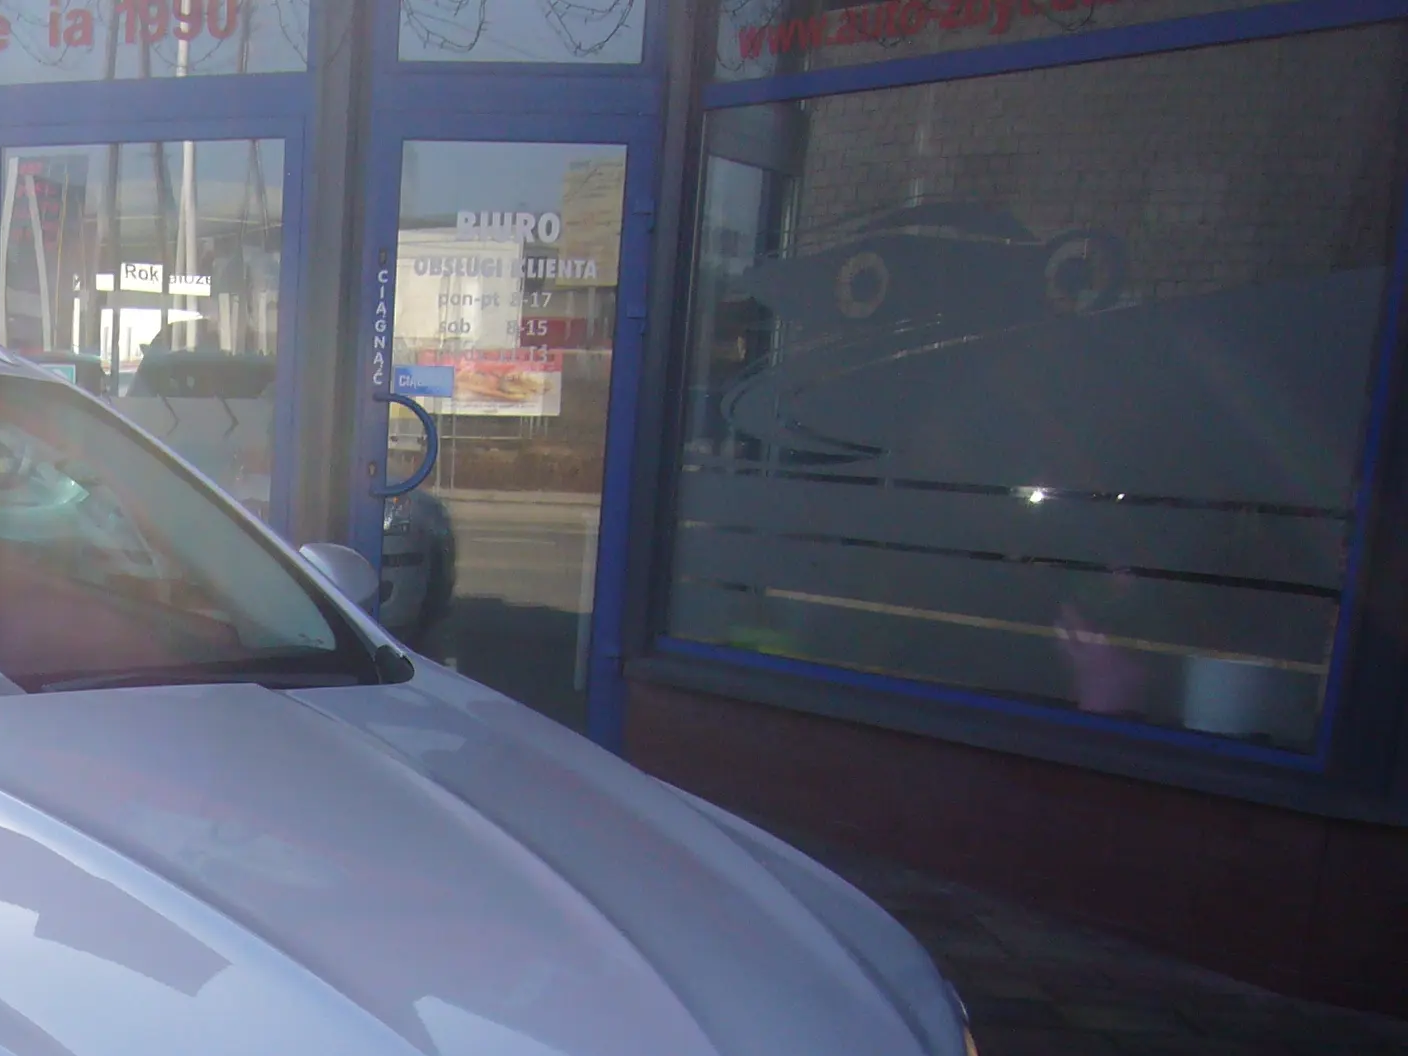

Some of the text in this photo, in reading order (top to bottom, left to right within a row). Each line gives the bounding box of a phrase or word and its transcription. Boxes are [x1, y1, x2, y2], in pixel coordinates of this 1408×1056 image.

[115, 0, 238, 45] 1990
[456, 211, 561, 243] BIURO
[511, 258, 598, 279] KLIENTA
